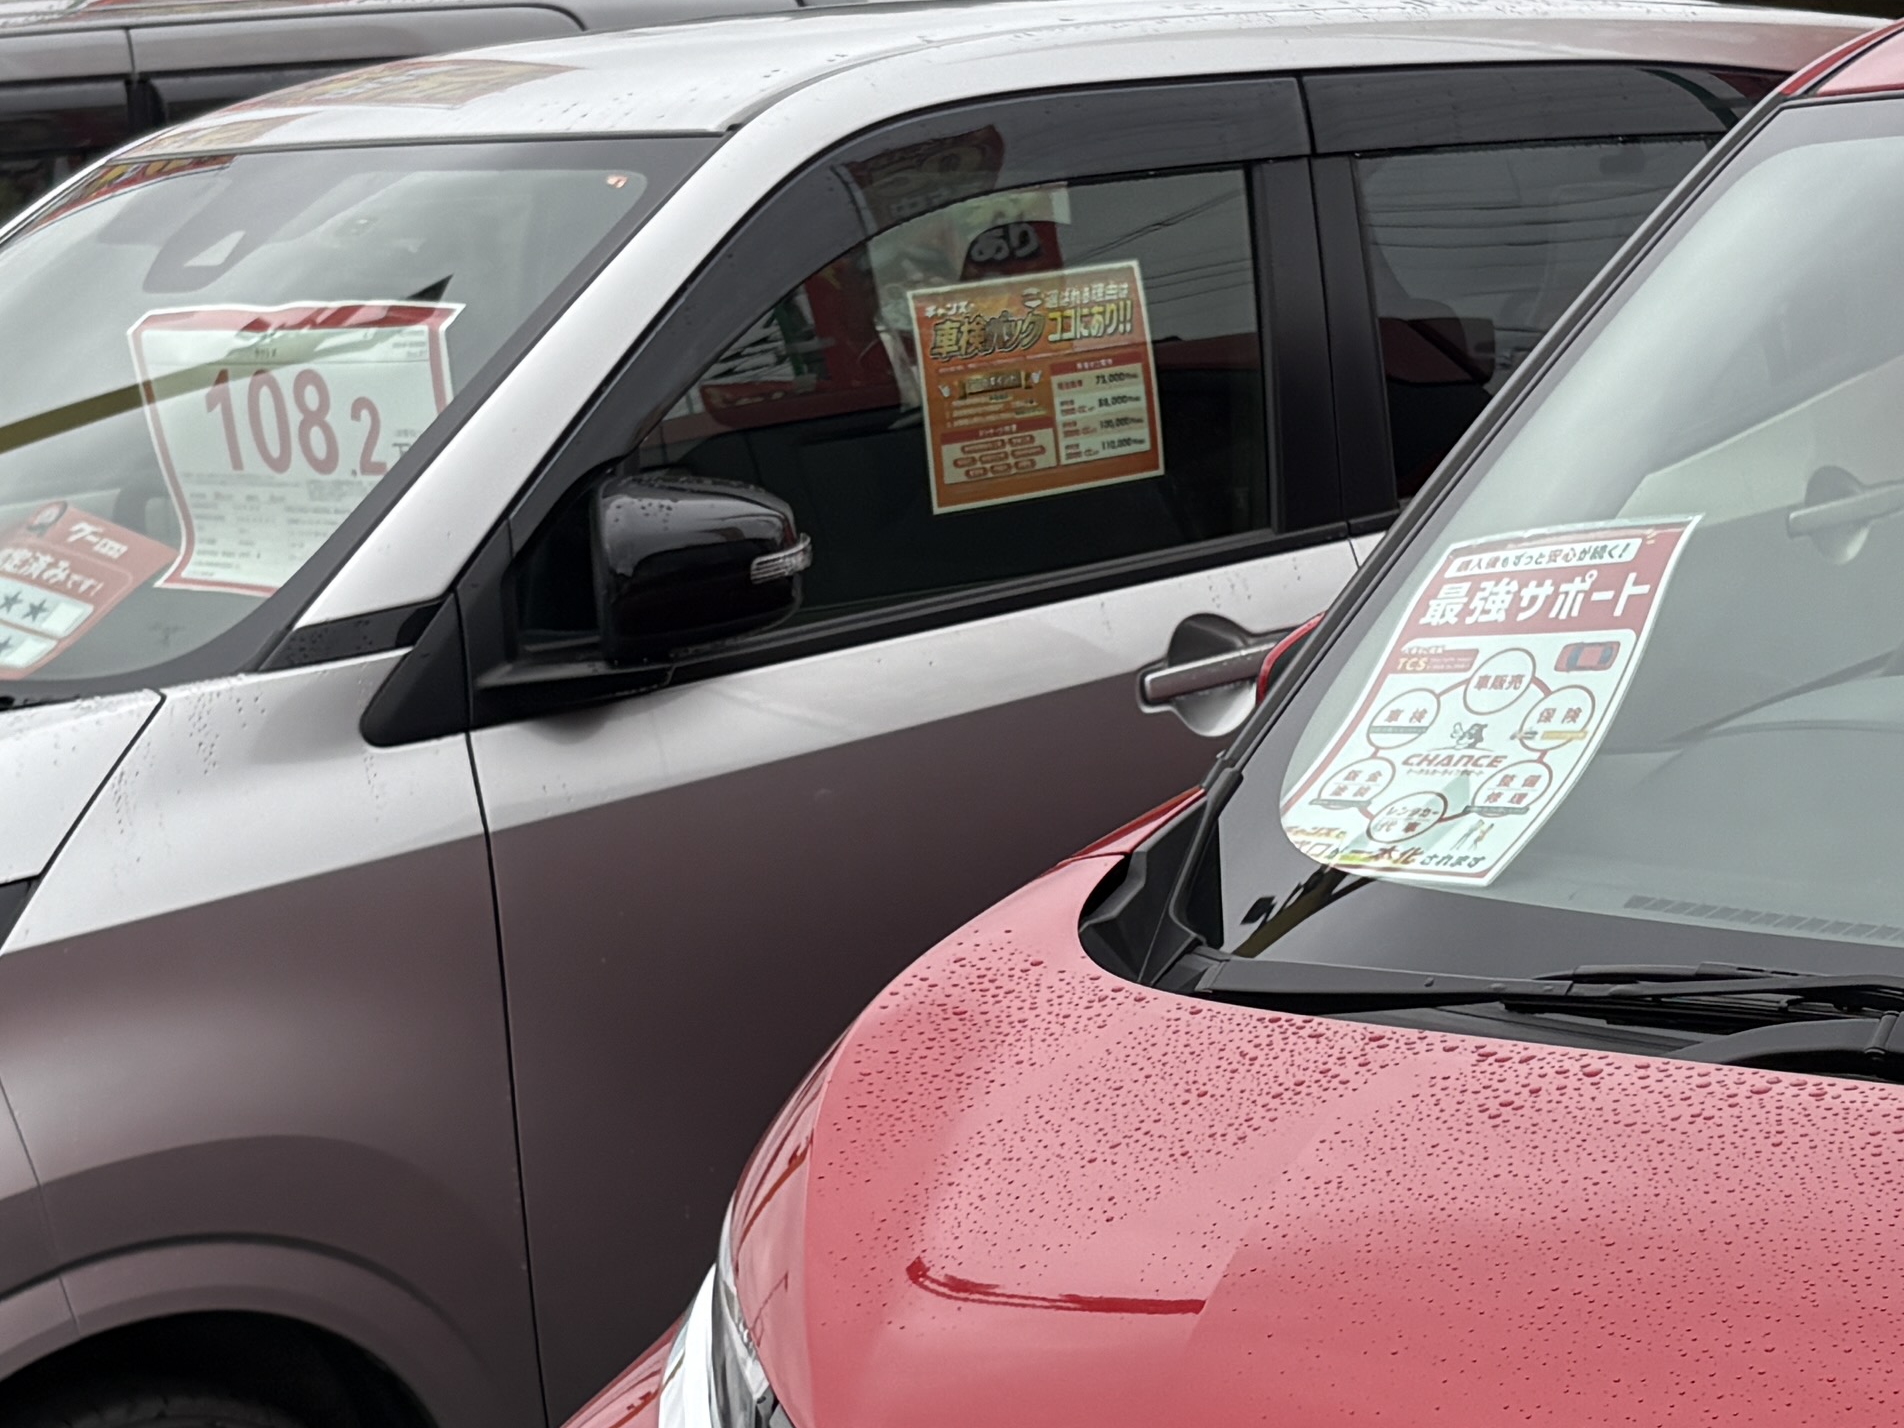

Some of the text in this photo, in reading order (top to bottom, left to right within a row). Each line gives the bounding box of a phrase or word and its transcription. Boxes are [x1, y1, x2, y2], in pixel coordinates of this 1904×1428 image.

[1419, 569, 1650, 626] 最強サポート
[1401, 753, 1508, 769] CHANCE
